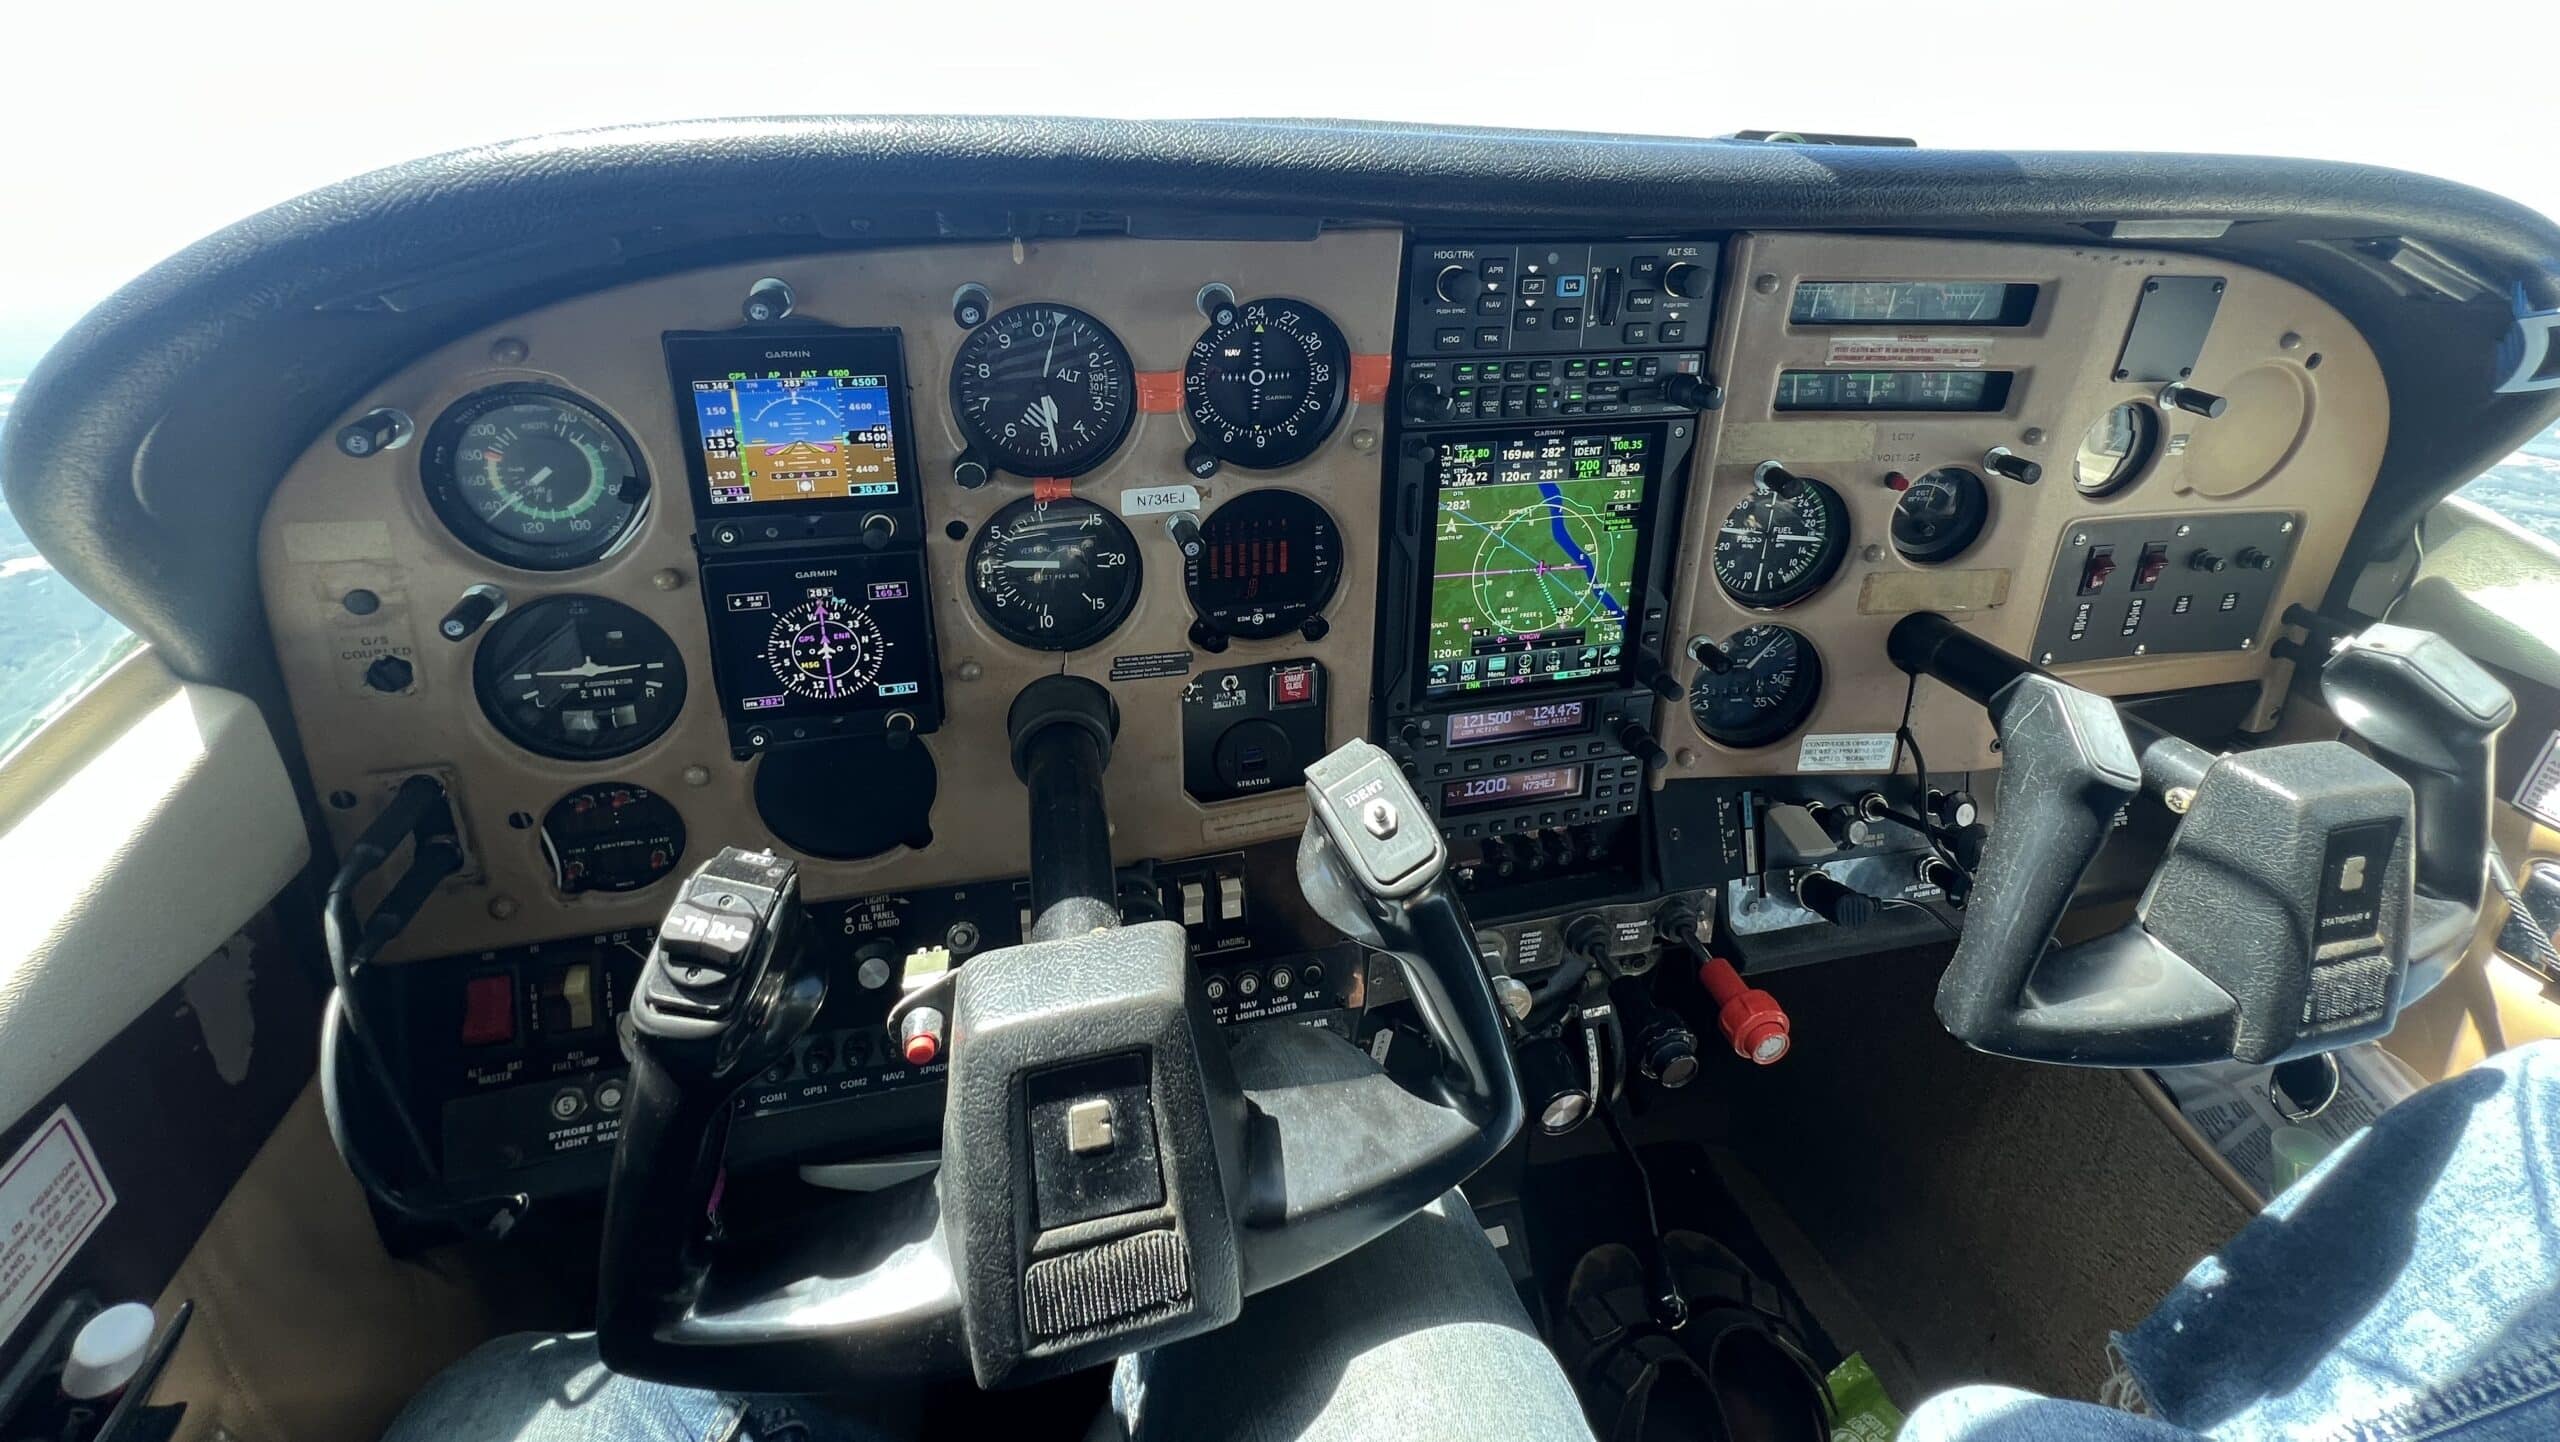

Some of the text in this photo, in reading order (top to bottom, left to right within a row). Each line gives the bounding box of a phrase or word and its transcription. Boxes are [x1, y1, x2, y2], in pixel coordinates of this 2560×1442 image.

[1434, 251, 1474, 259] HDG/TRK
[1668, 248, 1681, 256] ALT
[1488, 266, 1503, 274] APR
[1641, 263, 1652, 271] IAS
[1566, 282, 1578, 290] LVL
[1486, 300, 1501, 309] NAV
[1634, 297, 1651, 305] VNAV
[1248, 307, 1264, 319] 24
[1280, 311, 1299, 326] 27
[1526, 317, 1536, 325] FD
[1032, 322, 1044, 337] 0
[1669, 328, 1680, 336] ALT
[1000, 335, 1010, 348] 9
[1306, 332, 1322, 350] 30
[1443, 335, 1459, 343] HDG
[1484, 334, 1498, 342] TRK
[766, 351, 810, 359] GARMIN
[1193, 342, 1208, 358] 18
[1089, 353, 1100, 367] 2
[979, 364, 990, 378] 8
[1057, 368, 1080, 383] ALT
[1317, 364, 1328, 382] 33
[852, 378, 877, 386] 4500
[1187, 375, 1199, 392] 15
[979, 397, 990, 411] 7
[1093, 397, 1103, 411] 3
[706, 407, 726, 415] 150
[1195, 407, 1210, 424] 12
[1005, 423, 1016, 437] 6
[1073, 420, 1085, 433] 4
[708, 438, 735, 449] 135
[1040, 433, 1050, 446] 5
[1614, 440, 1642, 450] 108.35
[1458, 449, 1489, 459] 122.80
[1575, 447, 1602, 456] IDENT
[856, 465, 879, 473] 4400
[1574, 460, 1599, 470] 1200
[716, 471, 736, 479] 120
[860, 485, 888, 493] 30.09
[1137, 493, 1185, 506] N734EJ
[1802, 509, 1814, 517] 22
[1089, 514, 1102, 525] 15
[1723, 520, 1734, 528] 25
[1805, 519, 1816, 528] 20
[523, 521, 544, 532] 120
[570, 520, 591, 531] 100
[1773, 526, 1793, 535] FUEL
[992, 527, 1000, 538] 5
[1109, 554, 1125, 565] 20
[1727, 560, 1735, 568] 15
[1789, 558, 1797, 567] 10
[795, 570, 837, 578] GARMIN
[1744, 571, 1752, 580] 10
[875, 589, 902, 597] 169.5
[997, 595, 1006, 606] 5
[1092, 599, 1104, 610] 15
[1040, 616, 1053, 628] 10
[788, 624, 800, 632] 24
[361, 636, 389, 645] G/S
[1744, 636, 1758, 647] 20
[1604, 658, 1616, 666] Out
[1284, 674, 1304, 683] SMART
[1461, 673, 1476, 681] MSG
[1488, 670, 1505, 678] Menu
[1770, 674, 1785, 684] 30
[813, 681, 824, 689] 12
[1431, 676, 1446, 684] Back
[1286, 682, 1302, 690] GLIDE
[1702, 684, 1709, 694] 5
[581, 688, 616, 698] 2 MIN
[646, 688, 655, 697] R
[1702, 700, 1709, 710] 3
[1753, 698, 1767, 707] 35
[1463, 711, 1511, 728] 121.500
[1533, 703, 1581, 719] 124.475
[1237, 778, 1270, 787] STRATUS
[1464, 779, 1507, 796] 1200
[1344, 778, 1383, 808] IDENT
[865, 896, 889, 905] LIGHTS
[873, 911, 896, 920] PANEL
[2321, 913, 2362, 927] STATIONAIR
[859, 919, 899, 932] ENG RADIO
[1218, 937, 1245, 947] LANDING
[1277, 973, 1287, 985] 10
[1210, 984, 1220, 995] 10
[1304, 991, 1320, 999] ALT
[1240, 1000, 1258, 1009] NAV
[1268, 1003, 1297, 1014] LIGHTS
[1236, 1010, 1265, 1020] LIGHTS
[1314, 1018, 1327, 1027] AIR
[851, 1057, 857, 1065] 5
[811, 1064, 818, 1072] 5
[882, 1071, 905, 1082] NAV2
[840, 1078, 867, 1089] COM2
[803, 1086, 827, 1096] GPS1
[760, 1093, 787, 1104] COM1
[549, 1125, 592, 1140] STROBE
[555, 1138, 589, 1150] LIGHT
